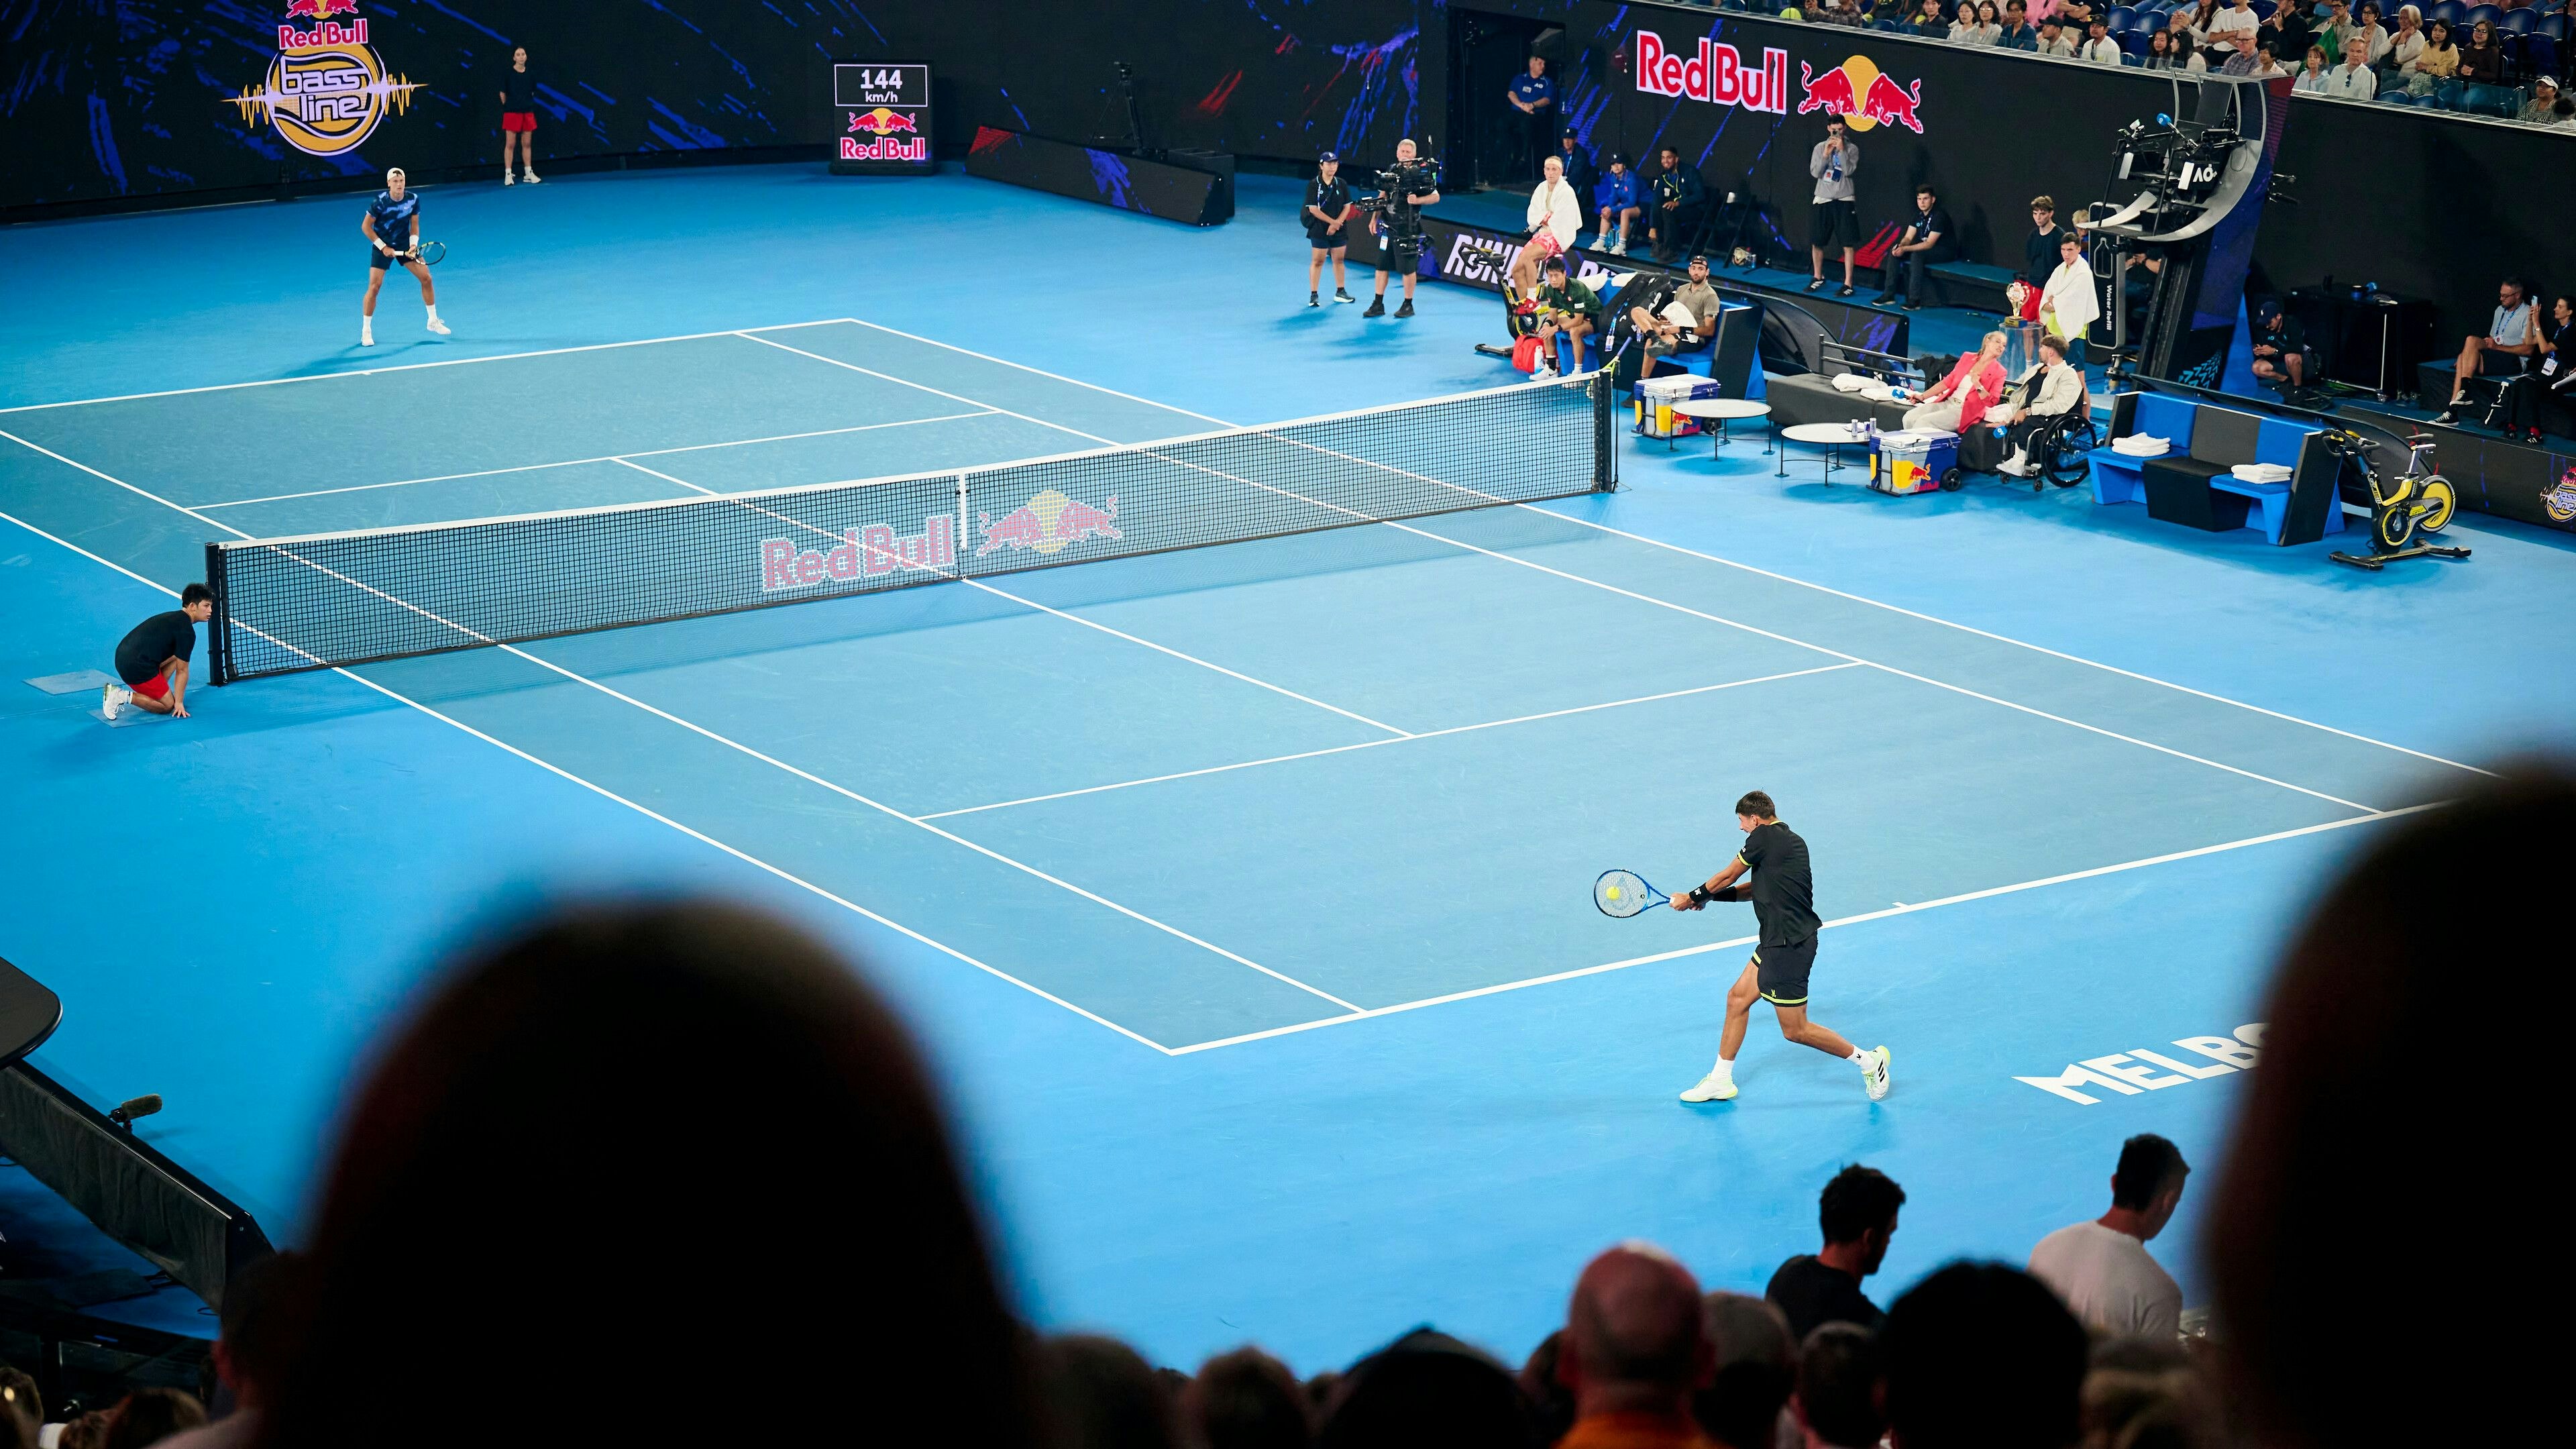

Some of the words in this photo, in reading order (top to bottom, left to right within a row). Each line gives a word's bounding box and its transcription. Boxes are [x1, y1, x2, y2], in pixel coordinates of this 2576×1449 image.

[278, 21, 323, 50] Red
[325, 18, 368, 46] Bull
[280, 56, 364, 95] bass
[860, 69, 903, 89] 144
[1637, 30, 1711, 102] Red
[1713, 42, 1787, 115] Bull
[301, 95, 369, 122] line
[865, 91, 898, 103] km/h
[841, 136, 883, 160] Red
[884, 138, 925, 160] Bull
[761, 527, 861, 592] Red
[862, 514, 955, 578] Bull
